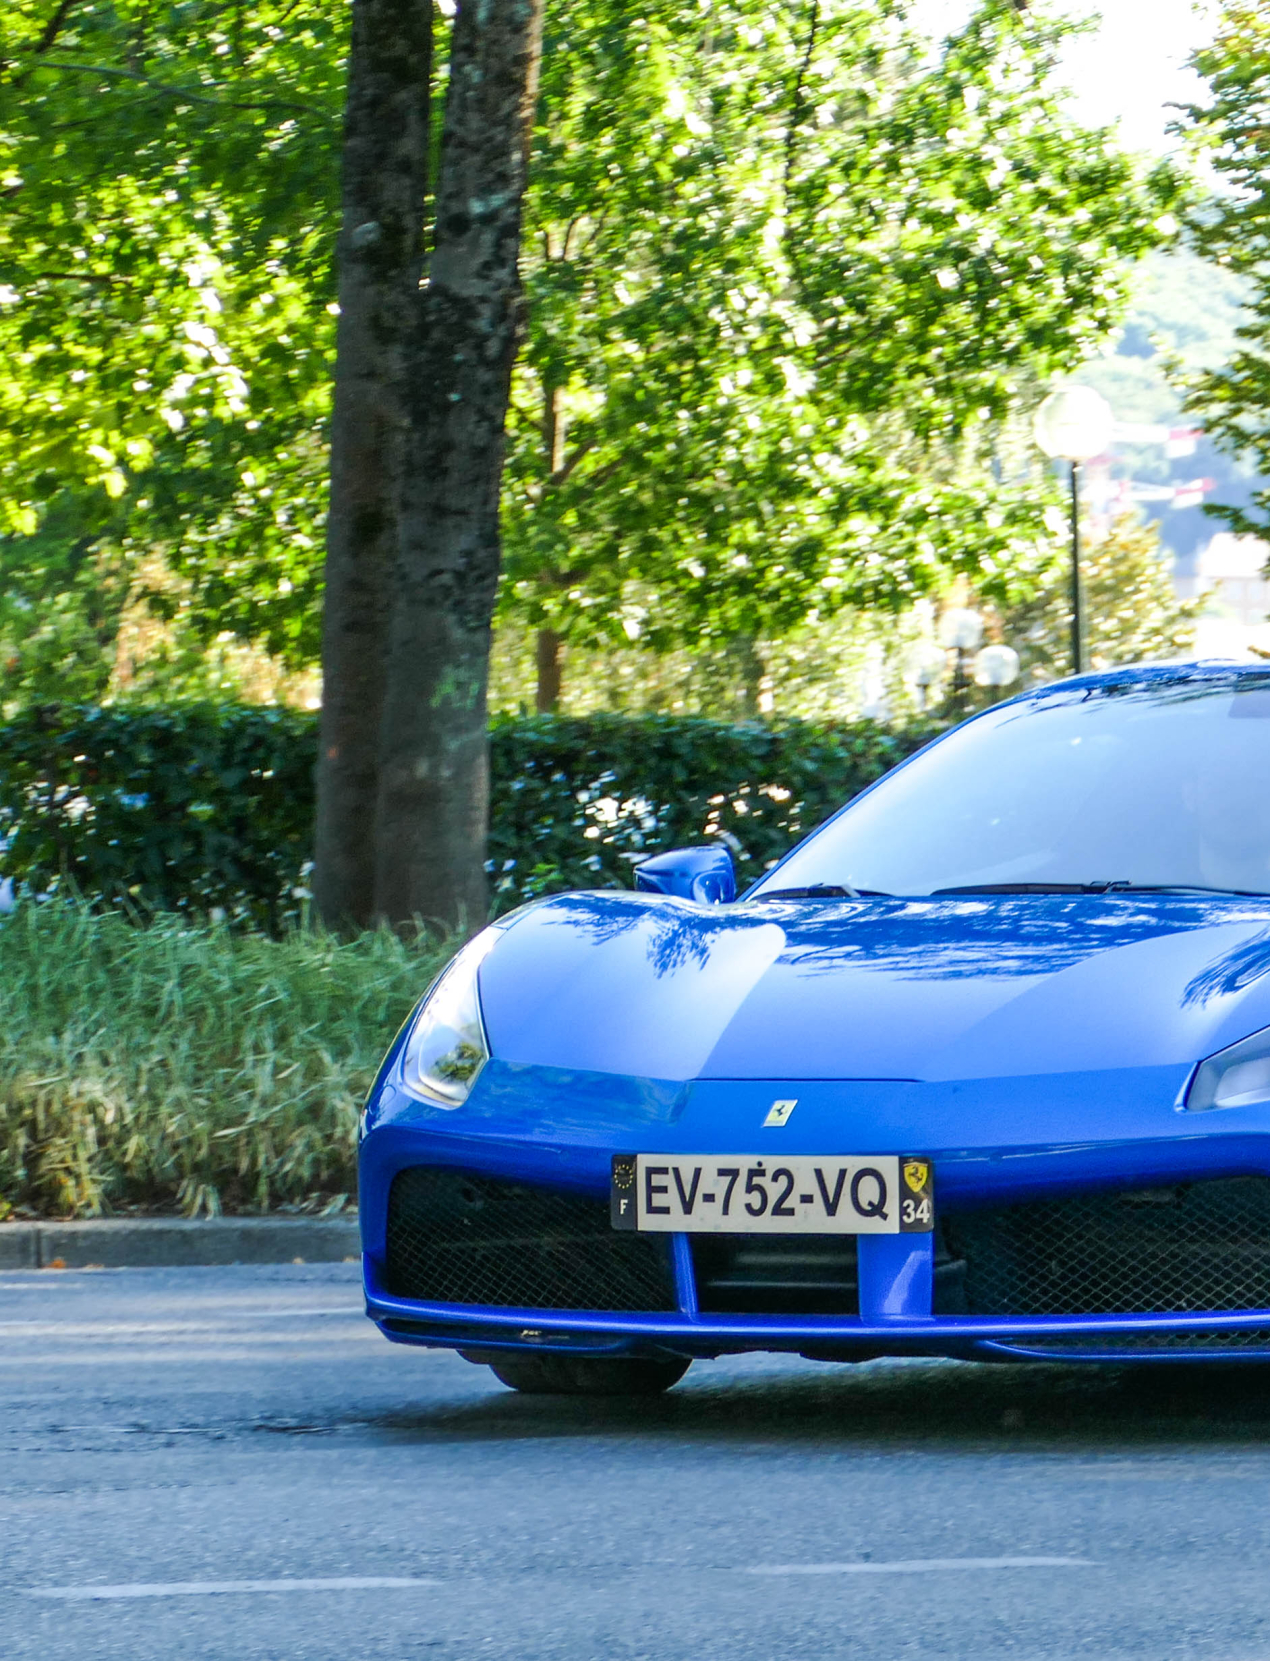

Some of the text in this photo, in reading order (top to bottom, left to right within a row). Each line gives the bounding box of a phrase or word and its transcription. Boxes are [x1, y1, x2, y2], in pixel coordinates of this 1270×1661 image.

[645, 1166, 888, 1221] EV-752-VQ
[619, 1199, 628, 1215] F
[902, 1199, 931, 1224] 34
